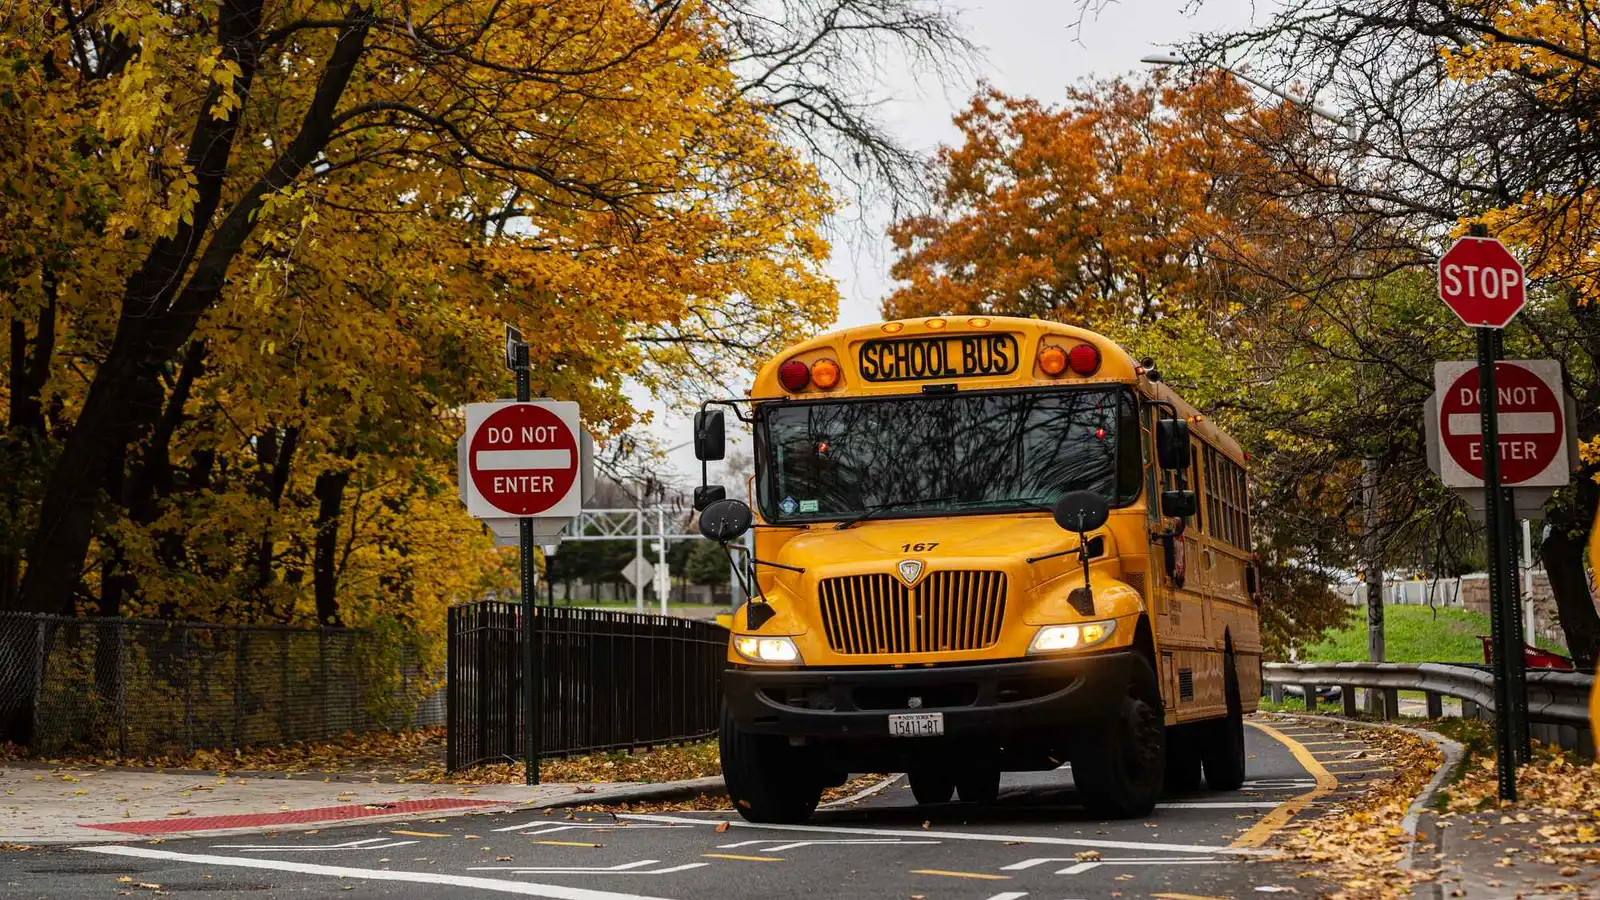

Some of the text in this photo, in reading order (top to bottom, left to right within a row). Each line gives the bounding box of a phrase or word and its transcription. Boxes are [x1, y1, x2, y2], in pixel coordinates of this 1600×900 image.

[1444, 264, 1519, 299] STOP
[863, 336, 1009, 378] SCHOOL BUS
[1498, 386, 1538, 405] NOT
[488, 426, 557, 444] DO NOT
[1469, 441, 1538, 460] ETER
[494, 476, 554, 493] ENTER
[902, 543, 939, 552] 167
